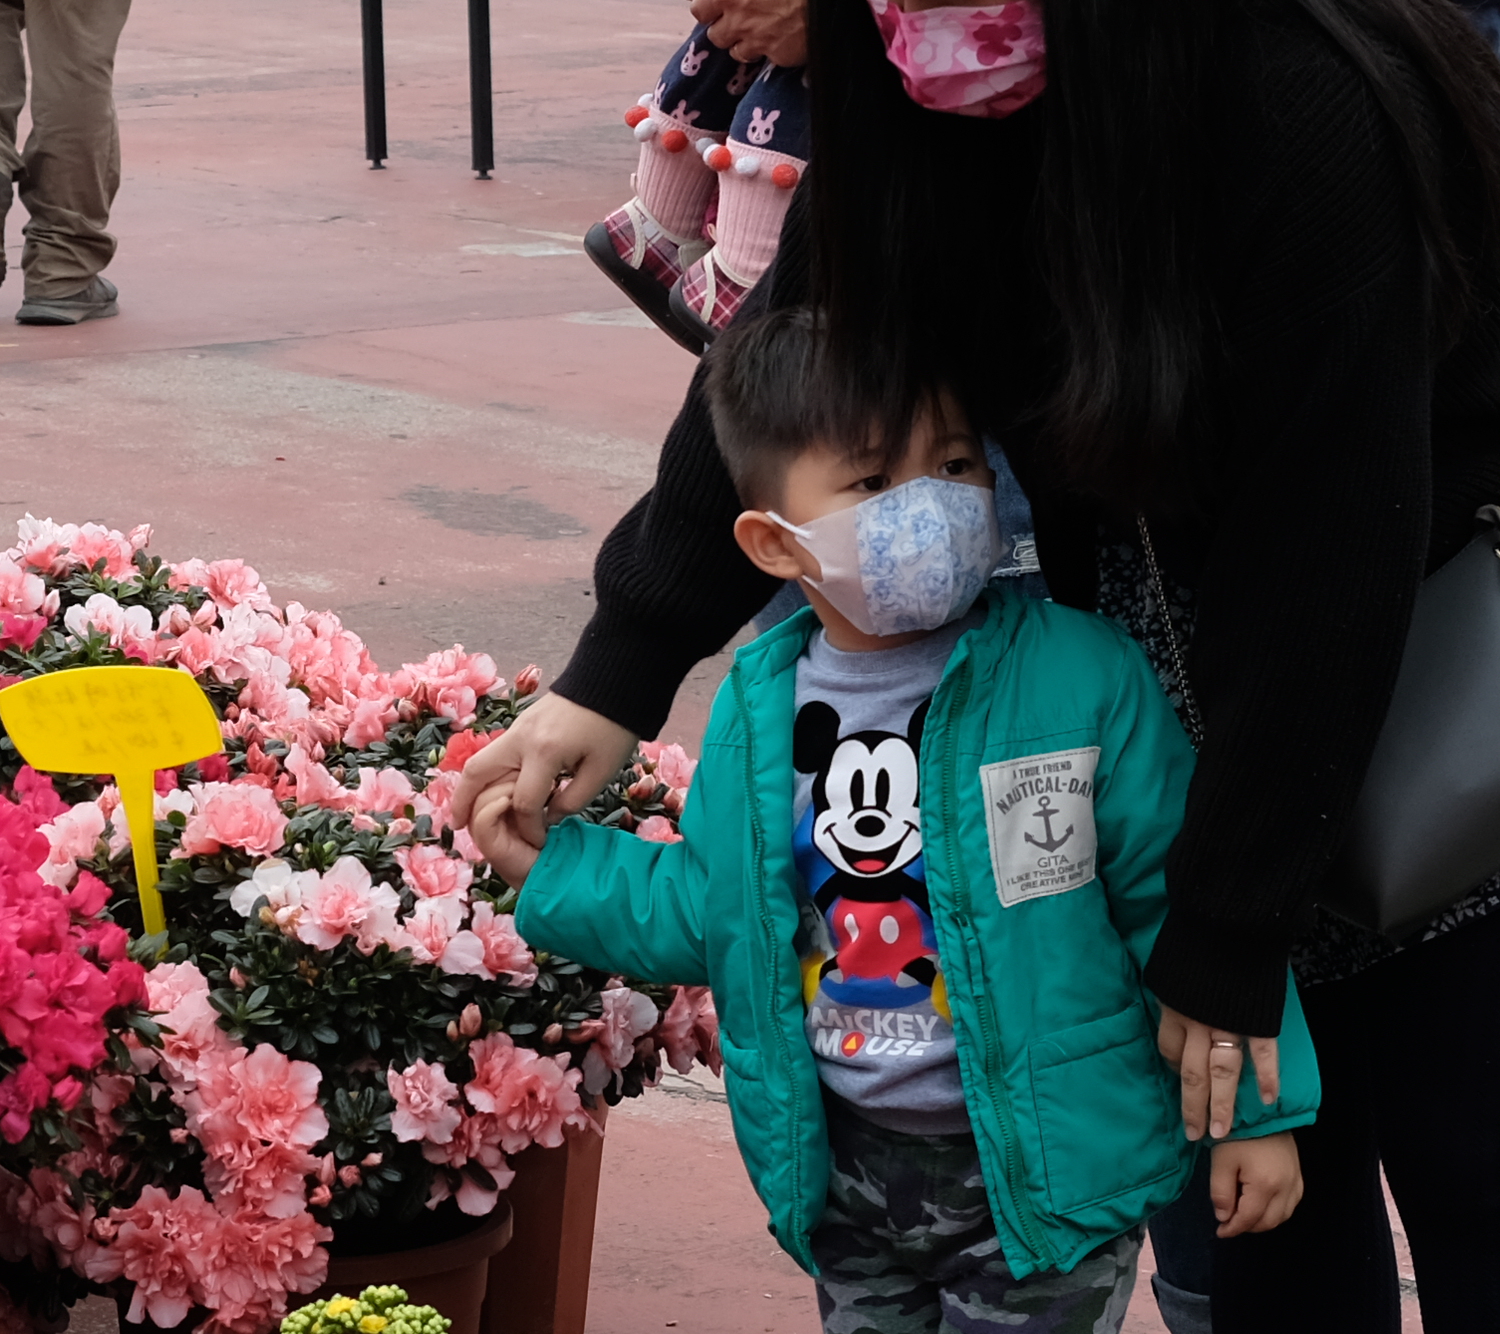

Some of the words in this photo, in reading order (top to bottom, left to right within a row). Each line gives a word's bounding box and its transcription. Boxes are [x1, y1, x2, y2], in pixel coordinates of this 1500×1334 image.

[1019, 765, 1040, 779] TRUE
[1043, 760, 1073, 774] FRIEND
[1037, 854, 1069, 868] GITA
[1011, 871, 1031, 885] LIKE
[1020, 874, 1067, 892] CREATIVE
